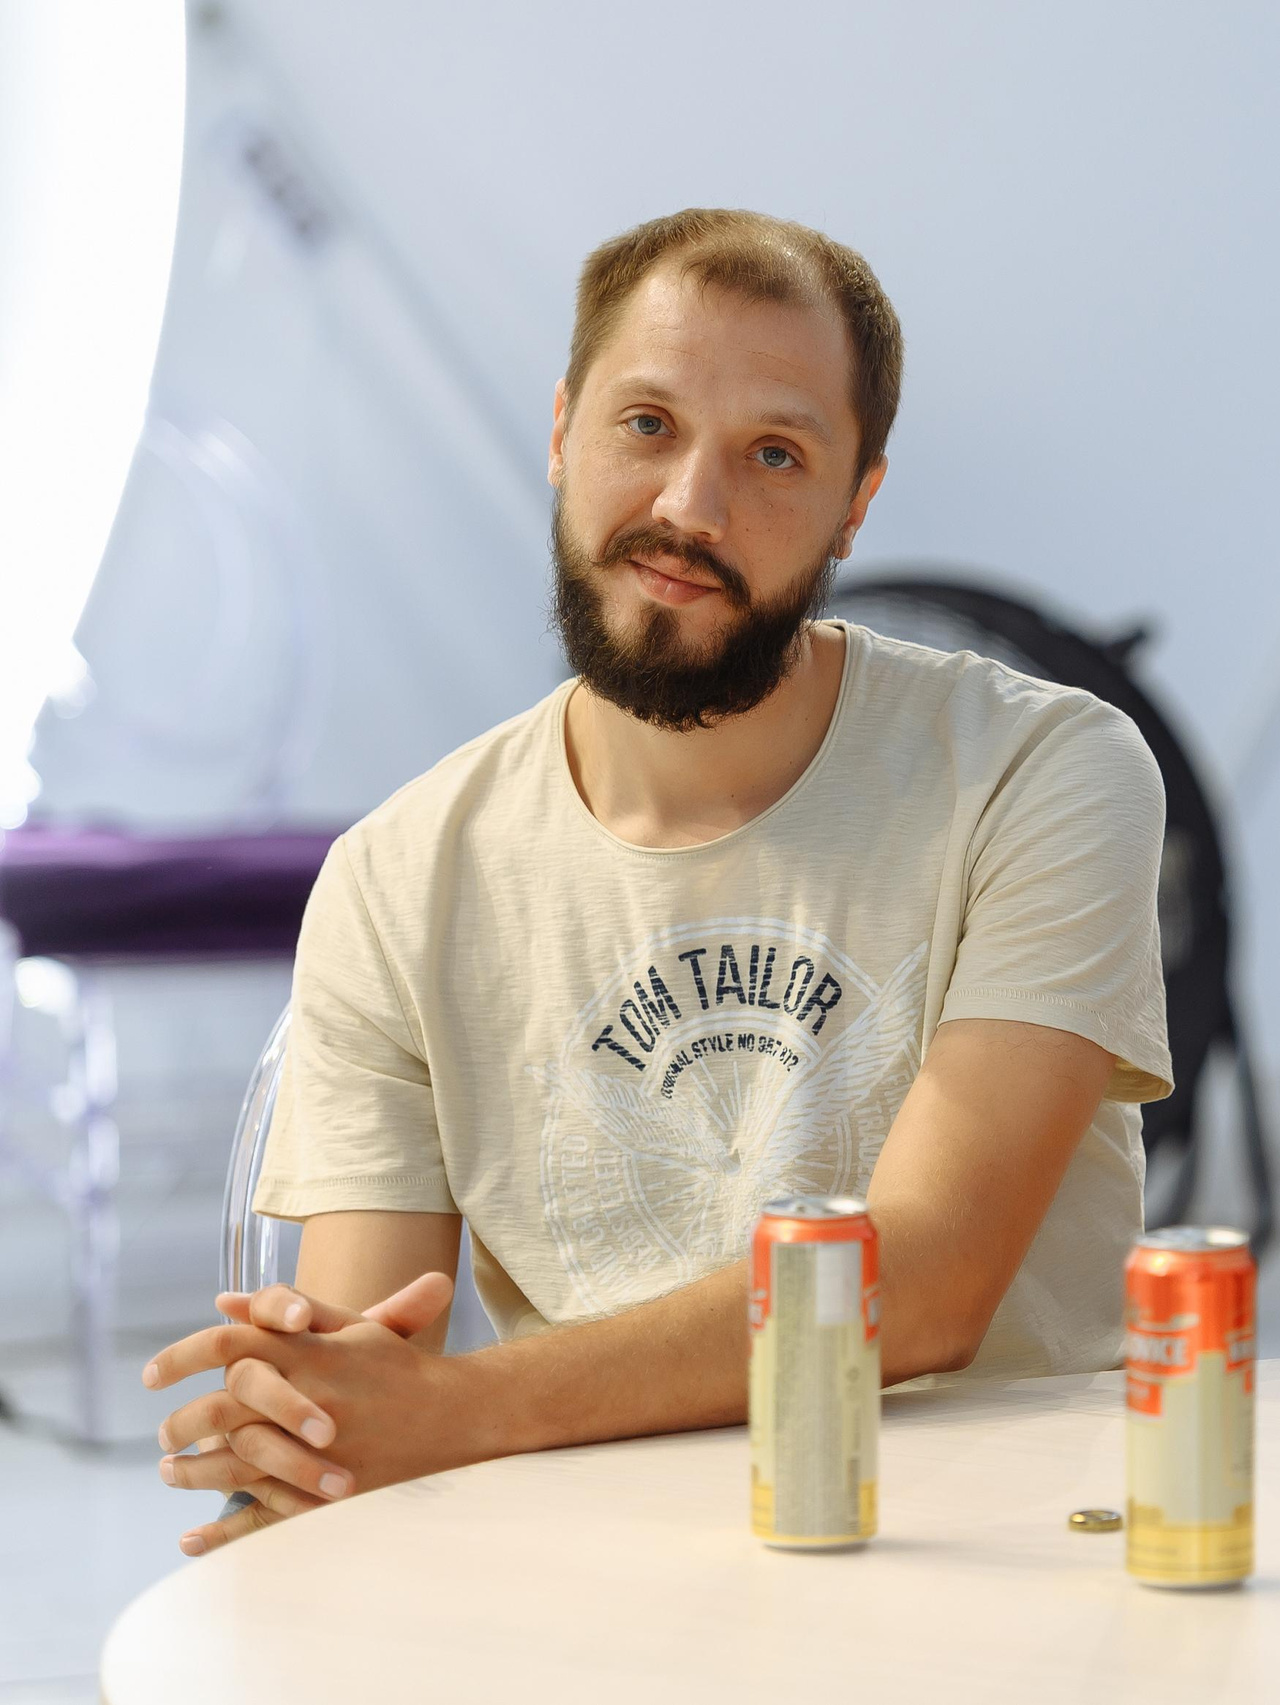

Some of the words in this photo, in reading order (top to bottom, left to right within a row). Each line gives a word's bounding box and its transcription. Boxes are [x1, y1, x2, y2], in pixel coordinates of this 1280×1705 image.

[591, 966, 682, 1072] TOM
[678, 945, 842, 1036] TAILOR
[691, 1033, 734, 1059] STYLE
[737, 1033, 755, 1052] NO
